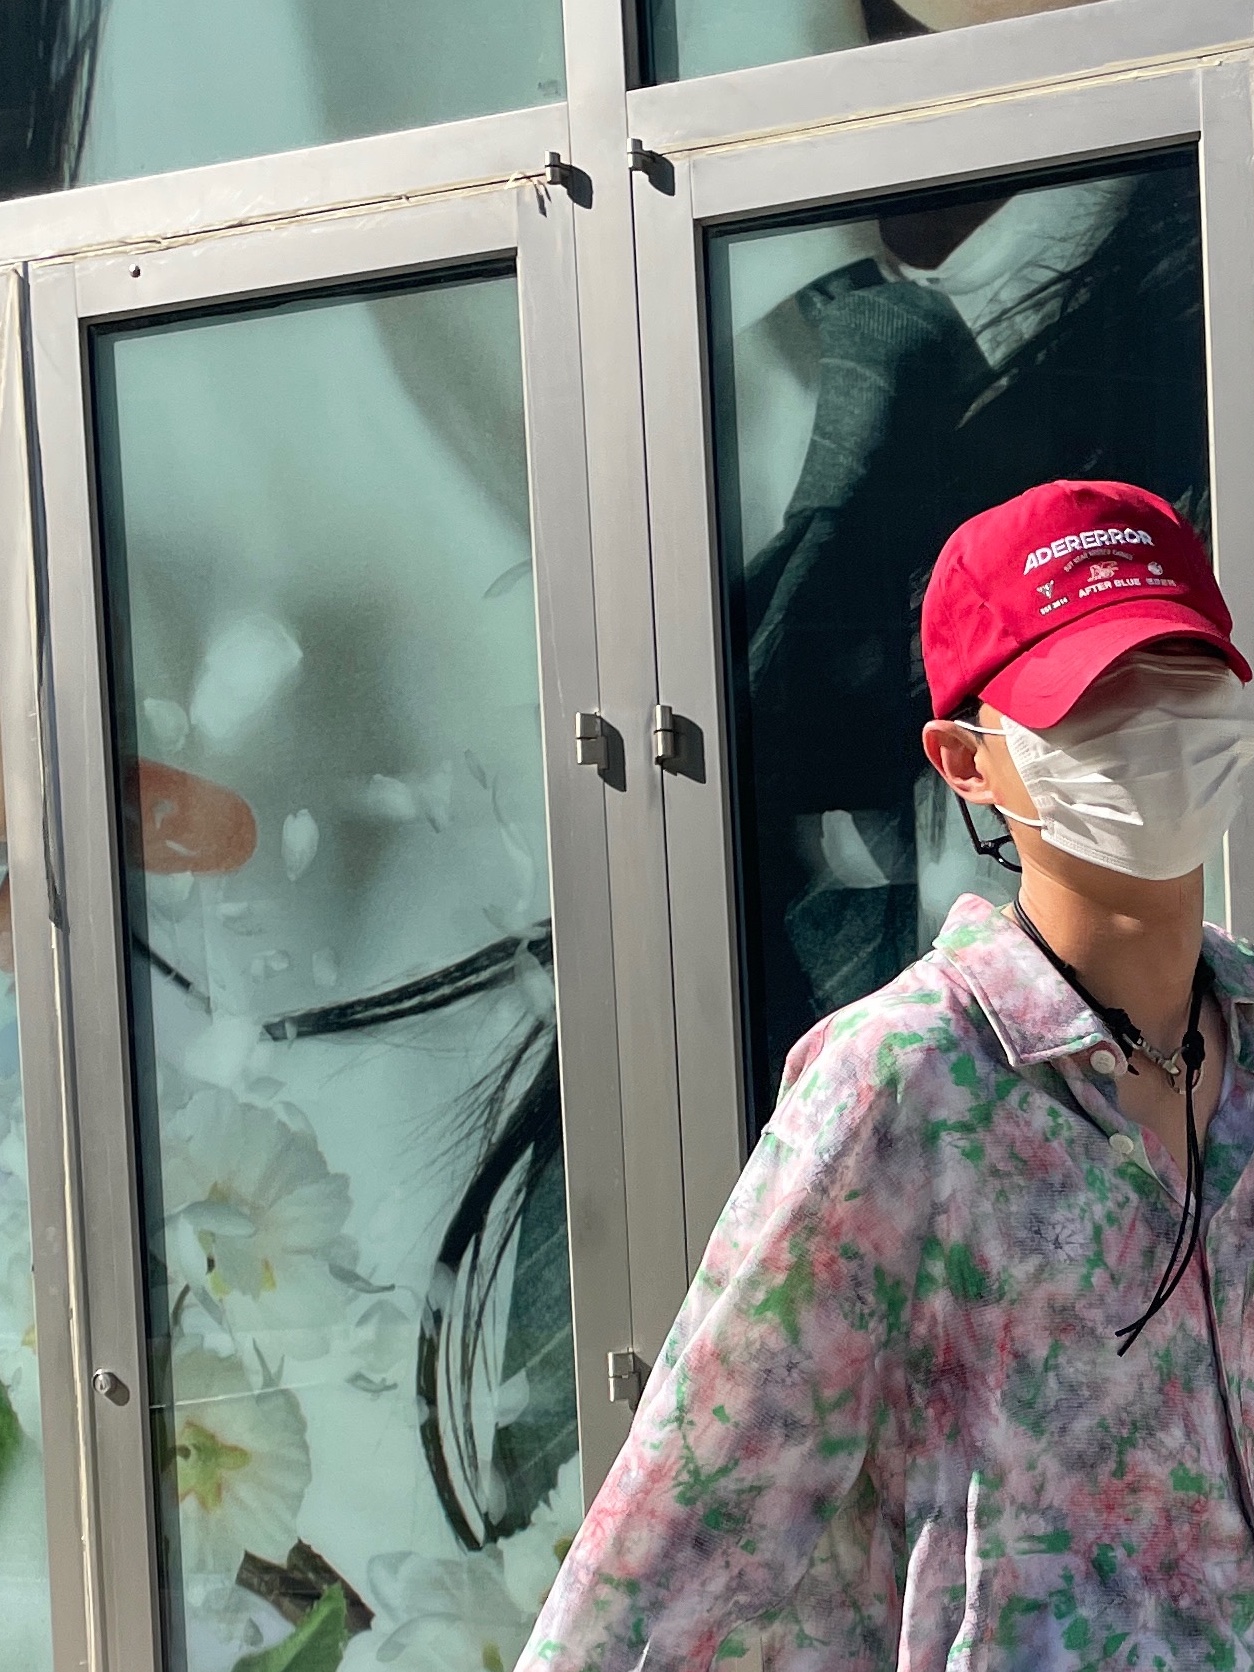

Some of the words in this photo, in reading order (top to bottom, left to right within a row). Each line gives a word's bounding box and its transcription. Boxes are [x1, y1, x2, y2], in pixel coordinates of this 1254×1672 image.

[1023, 528, 1155, 575] ADERERROR
[1079, 580, 1113, 598] AFTER
[1113, 577, 1142, 588] BLUE
